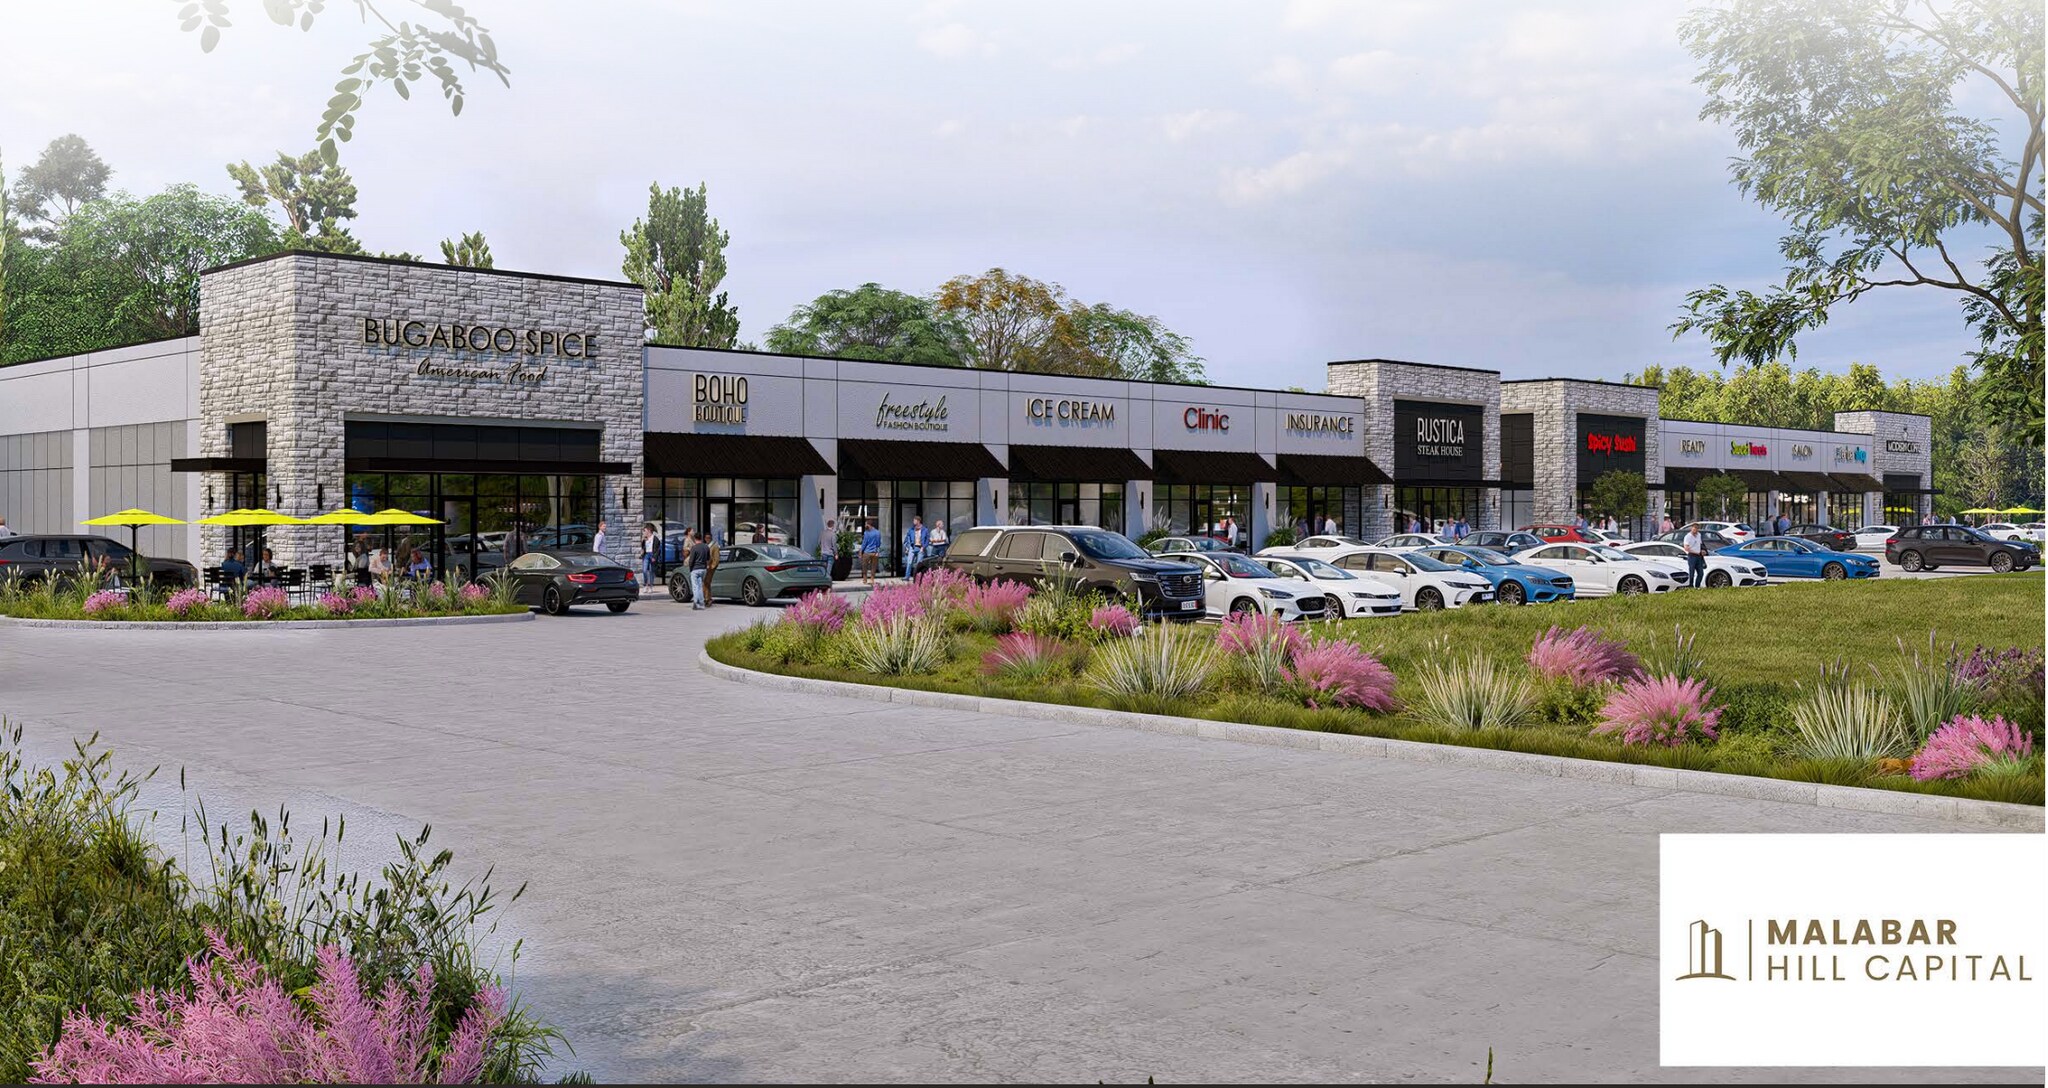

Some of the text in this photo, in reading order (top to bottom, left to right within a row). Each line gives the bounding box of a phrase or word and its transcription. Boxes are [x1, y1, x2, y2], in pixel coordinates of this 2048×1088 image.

[362, 317, 598, 358] BUGABOO SPICE
[416, 355, 549, 385] American Food
[693, 372, 748, 404] BOHO
[693, 404, 747, 424] BOUTIQUE
[876, 391, 948, 427] freestyle
[1025, 398, 1115, 421] ICE CREAM
[1184, 407, 1230, 431] Clinic
[883, 420, 948, 432] FASHION BOUTIQUE
[1285, 413, 1354, 433] INSURANCE
[1417, 417, 1464, 444] RUSTICA
[1417, 444, 1463, 457] STEAK HOUSE
[1680, 439, 1705, 453] REALTY
[1792, 443, 1813, 456] SALON
